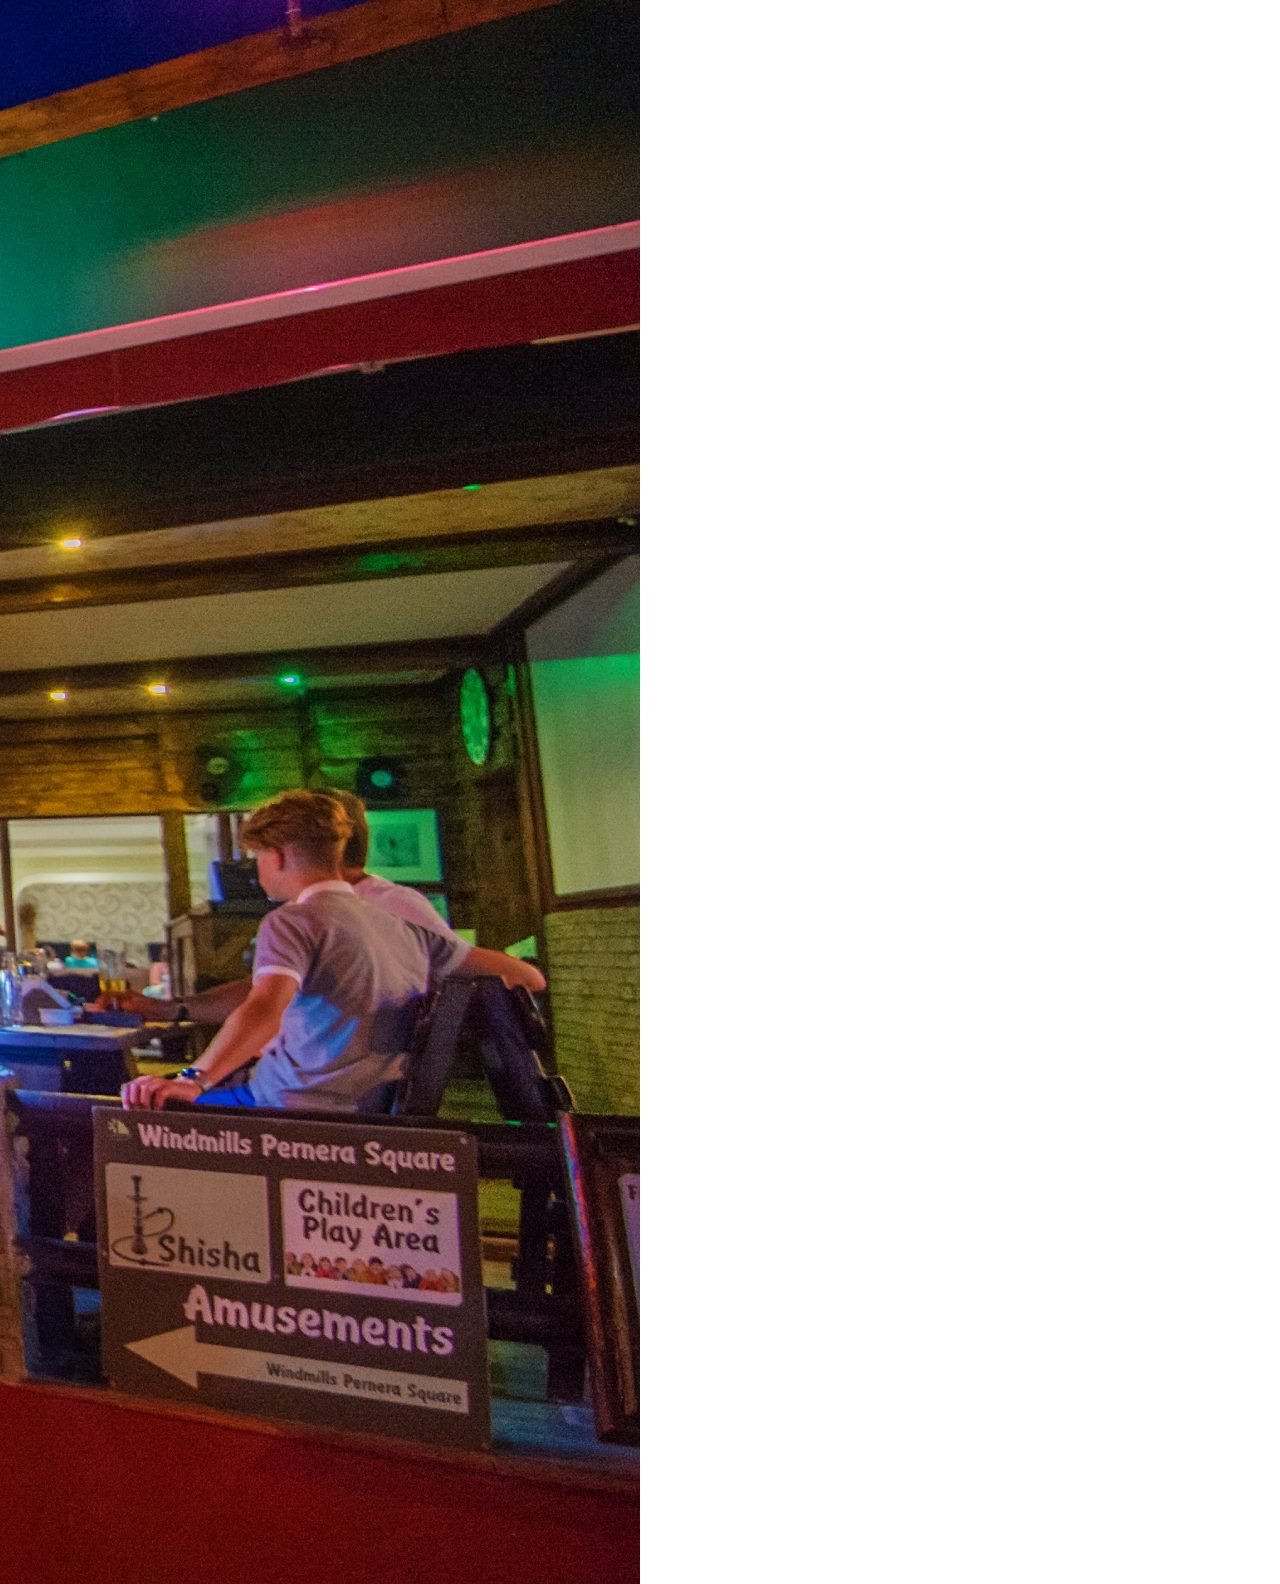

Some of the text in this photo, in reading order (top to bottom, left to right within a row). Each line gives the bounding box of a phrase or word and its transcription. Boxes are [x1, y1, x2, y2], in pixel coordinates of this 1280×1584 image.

[137, 1121, 457, 1173] Windmills Pernera Square
[297, 1188, 441, 1226] Children's
[157, 1233, 261, 1276] Shisha
[301, 1213, 440, 1255] Play Area
[182, 1283, 456, 1357] Amusements
[265, 1361, 463, 1408] Windmills Pernera Square
